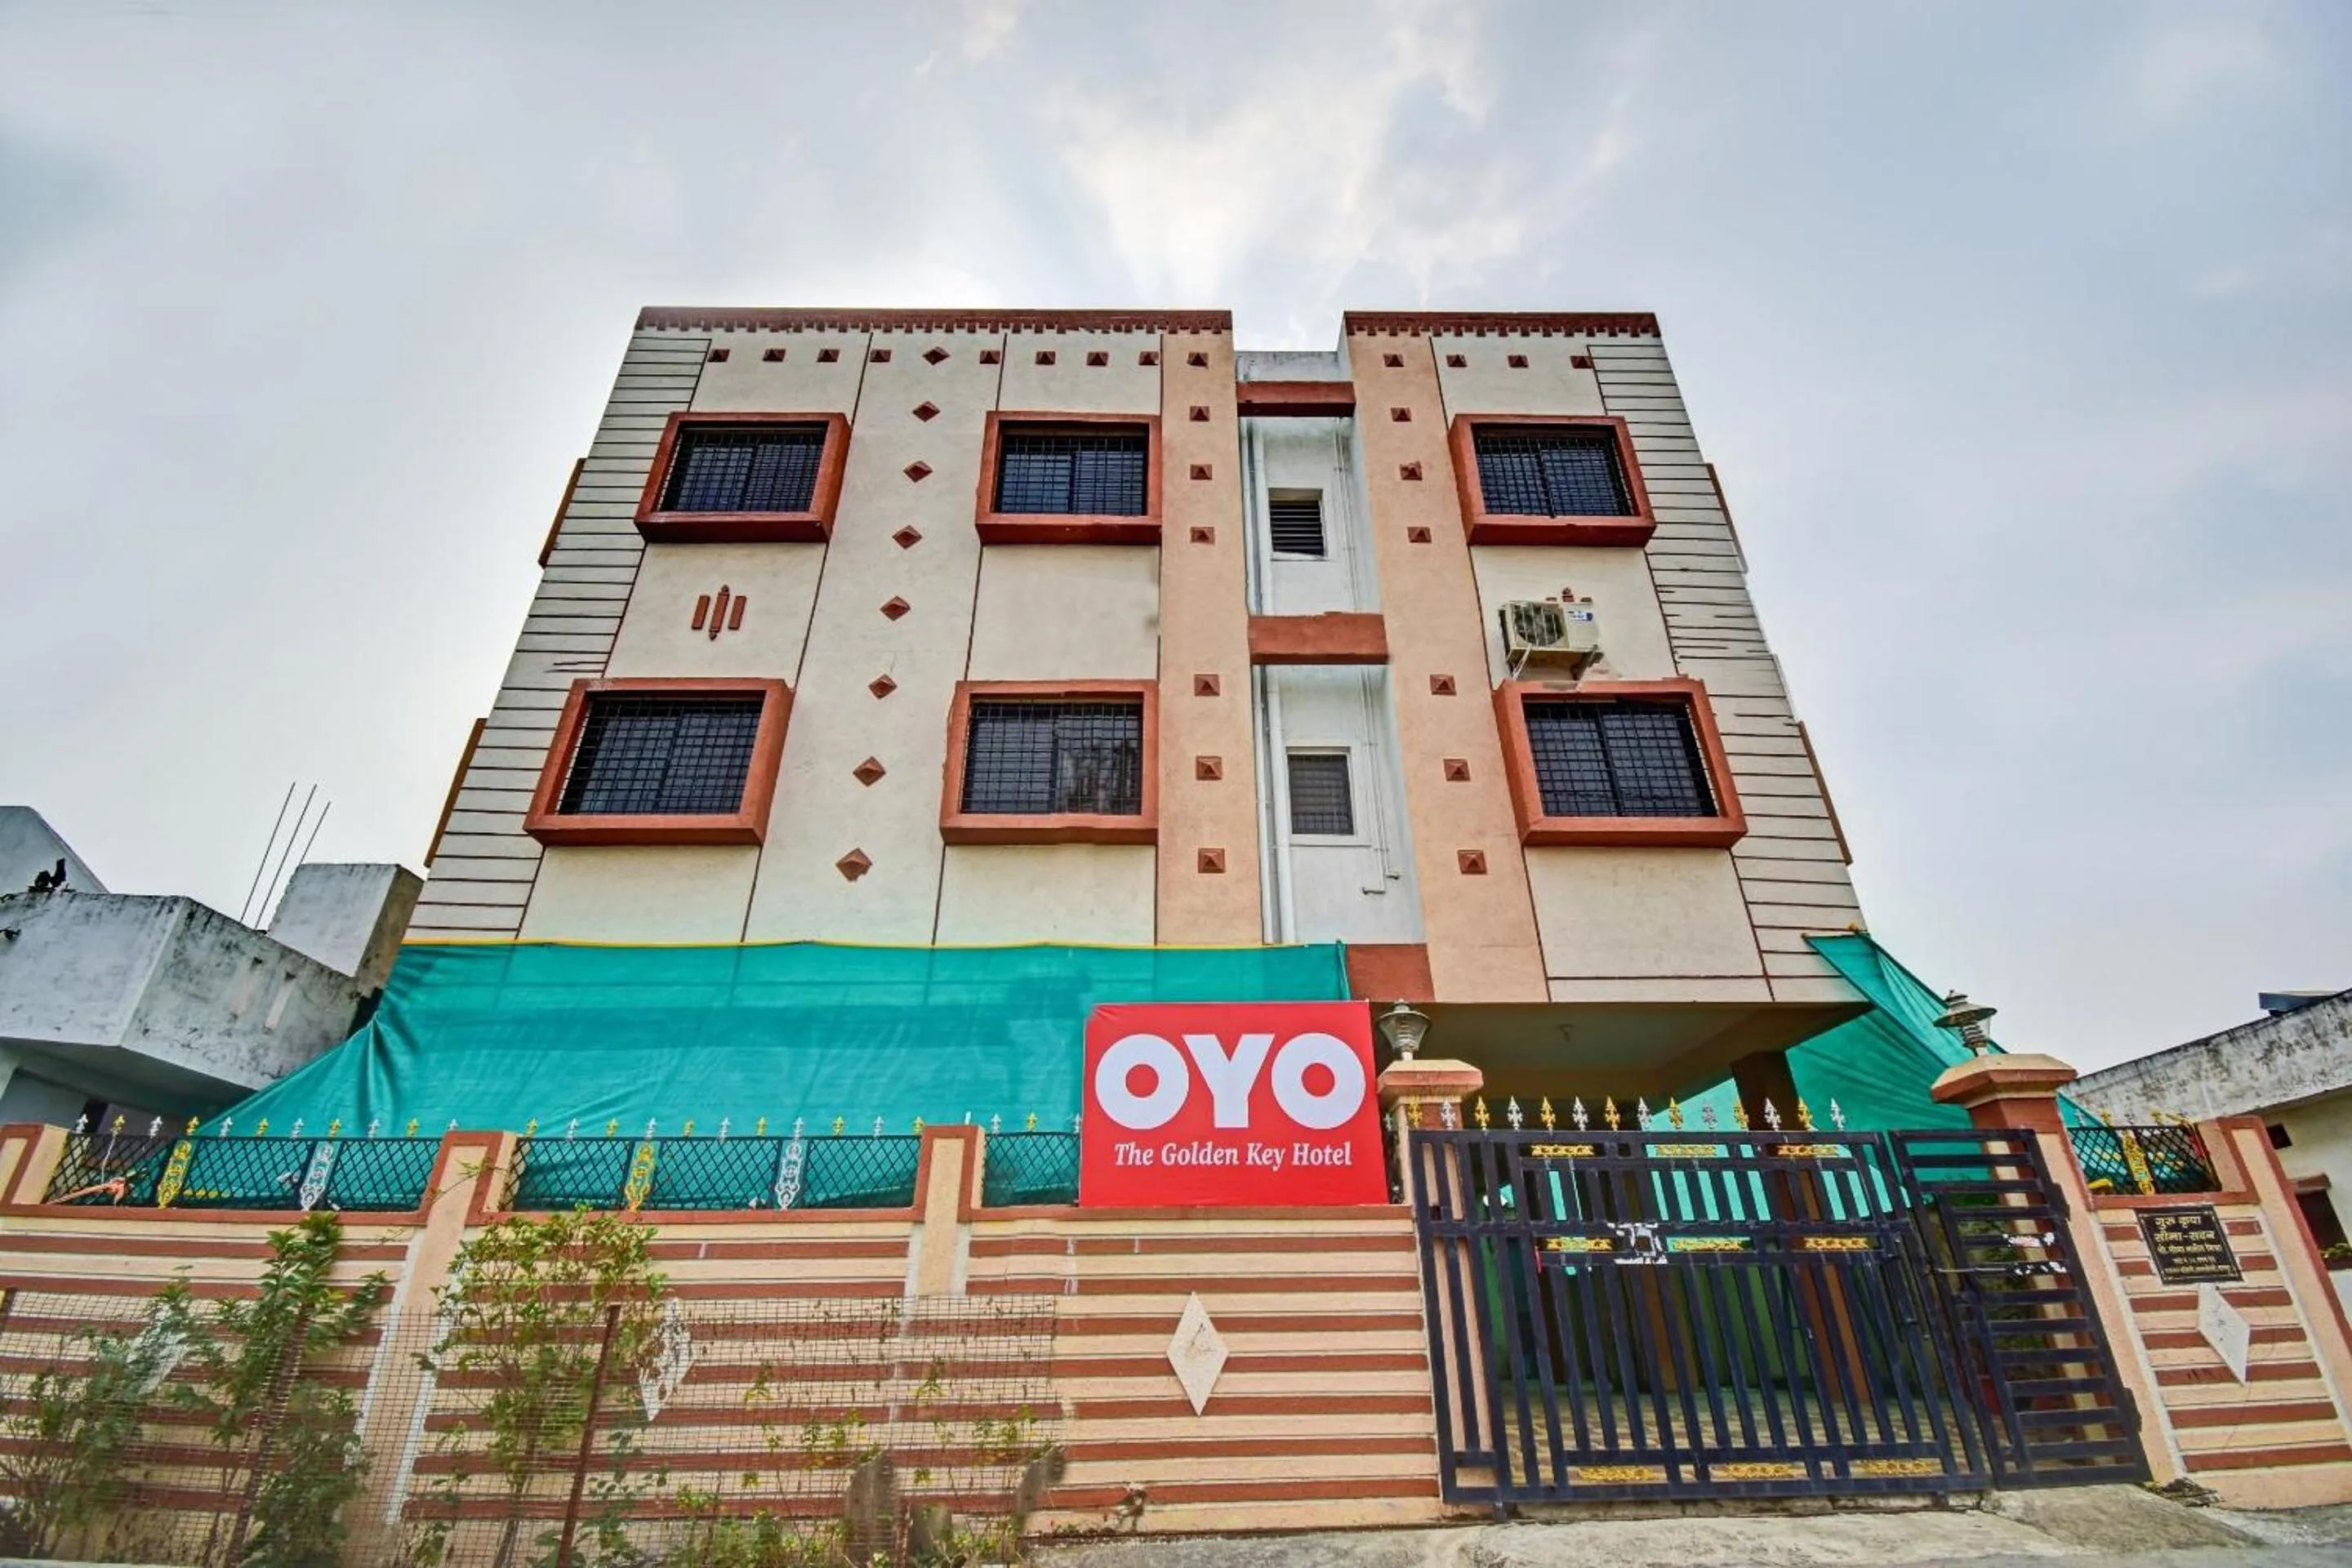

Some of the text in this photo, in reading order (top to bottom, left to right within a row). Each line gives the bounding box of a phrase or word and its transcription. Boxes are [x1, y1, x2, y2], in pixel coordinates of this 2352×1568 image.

[1095, 1032, 1366, 1129] OYO
[1115, 1141, 1352, 1171] The Golden Key Hotel
